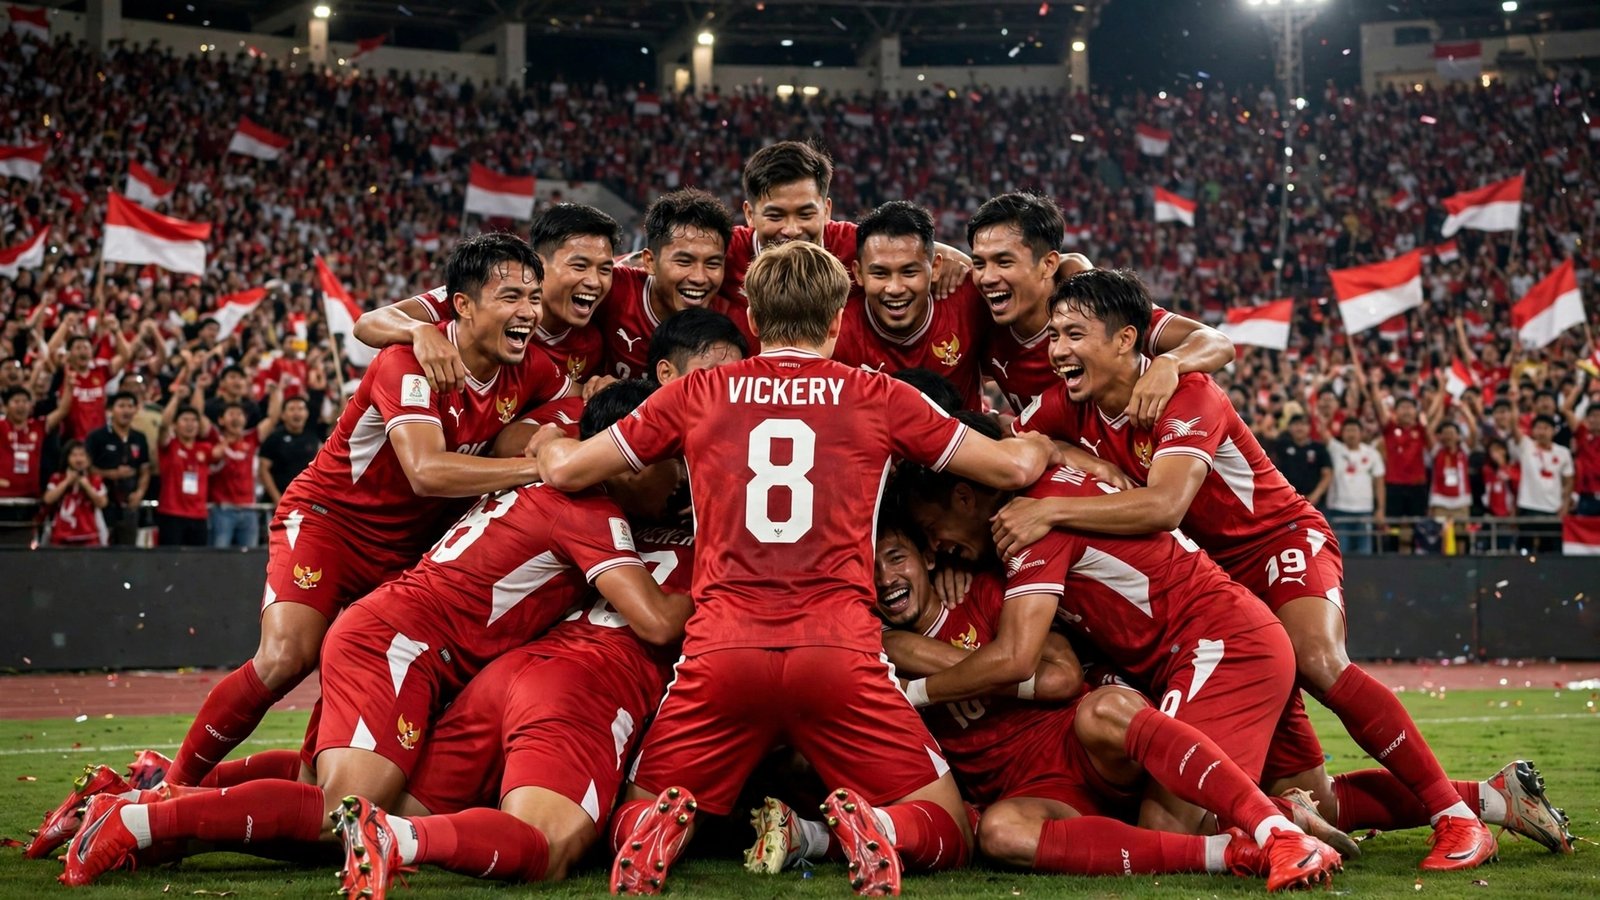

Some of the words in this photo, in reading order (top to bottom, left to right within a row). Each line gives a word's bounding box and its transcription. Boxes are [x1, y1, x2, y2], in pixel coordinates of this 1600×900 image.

[728, 376, 845, 405] VICKERY
[745, 418, 816, 543] 8
[1265, 548, 1307, 587] 19
